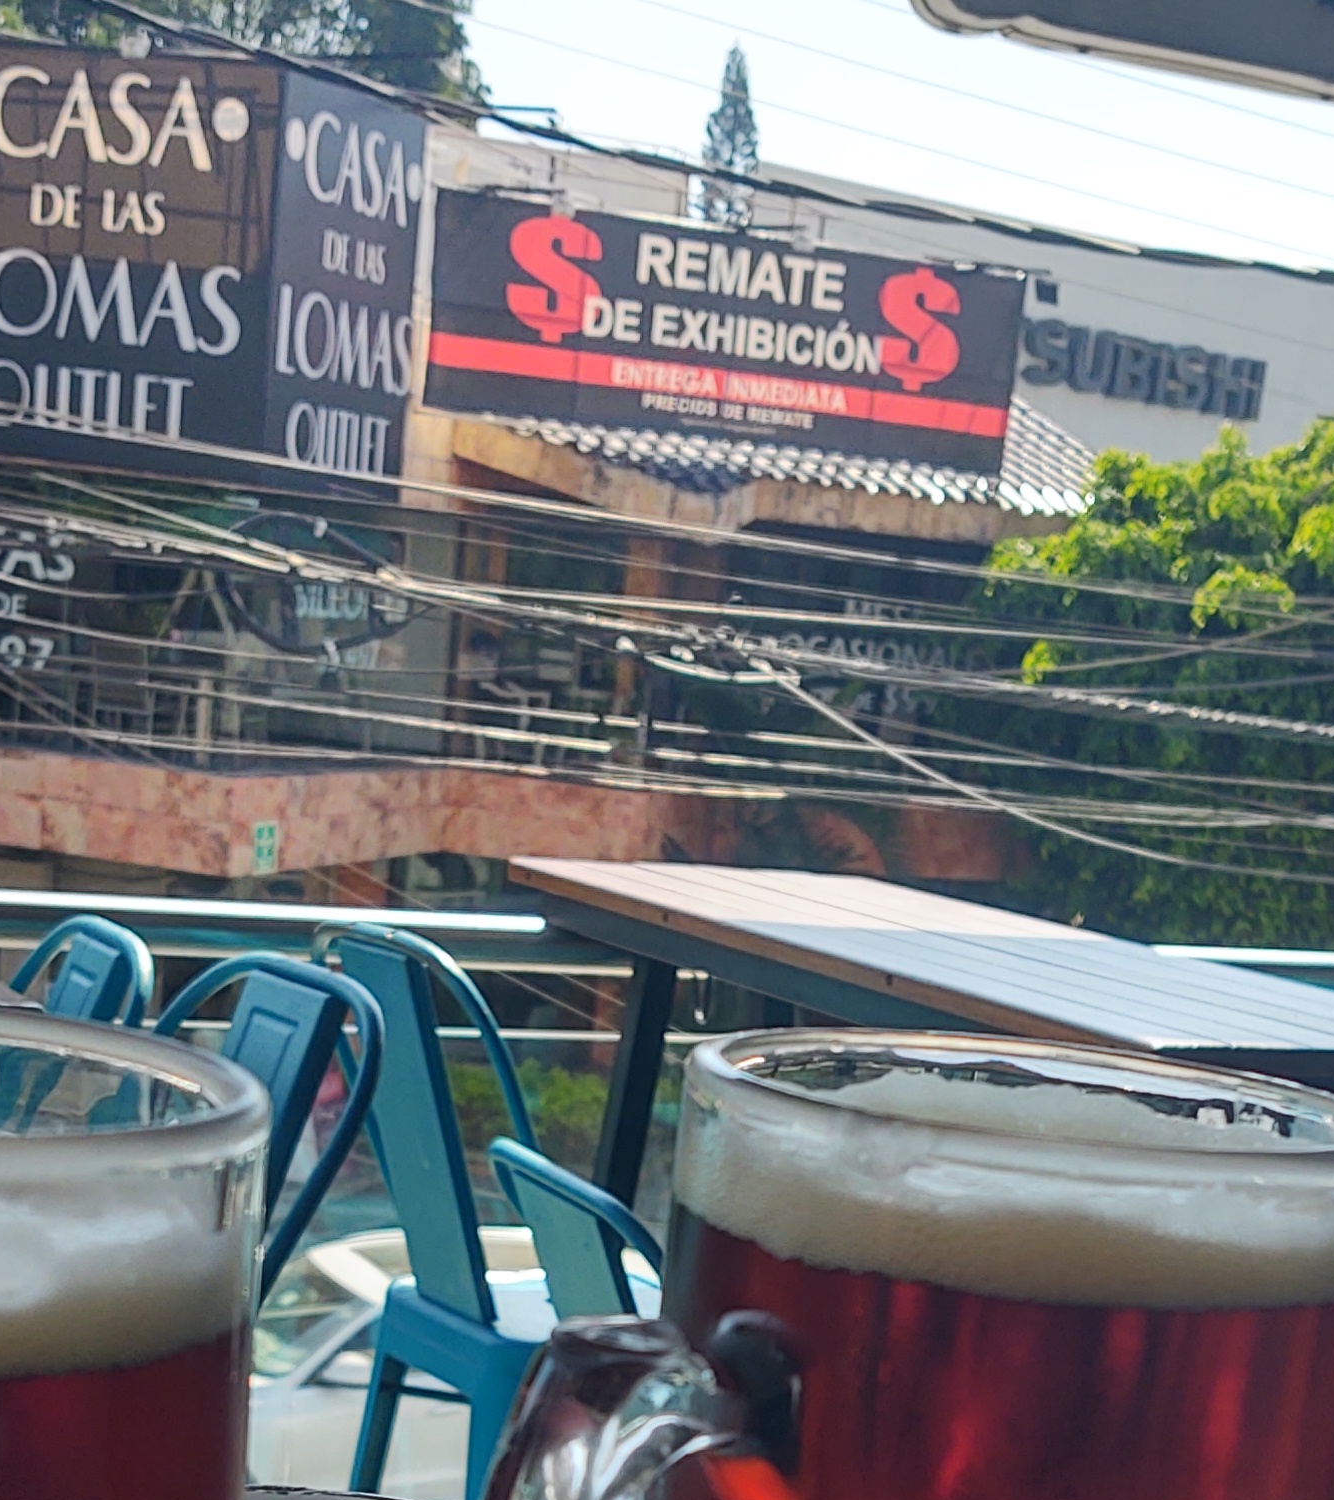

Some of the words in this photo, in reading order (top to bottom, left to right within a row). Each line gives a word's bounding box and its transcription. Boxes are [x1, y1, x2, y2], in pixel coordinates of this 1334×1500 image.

[304, 110, 408, 228] CASA
[29, 183, 82, 229] DE
[101, 188, 166, 236] LAS
[322, 229, 350, 275] DE
[354, 239, 386, 285] LAS
[635, 232, 847, 311] REMATE
[275, 283, 413, 397] LOMAS
[582, 296, 640, 343] DE
[650, 306, 881, 375] EXHIBICIÓN
[1020, 318, 1267, 424] SUBISHI
[611, 358, 717, 396] ENTREGA
[723, 372, 848, 414] INMEDIATA
[640, 392, 717, 418] PRECIOS
[722, 402, 744, 420] DE
[746, 406, 815, 430] REMATE
[285, 402, 391, 476] OUTLET
